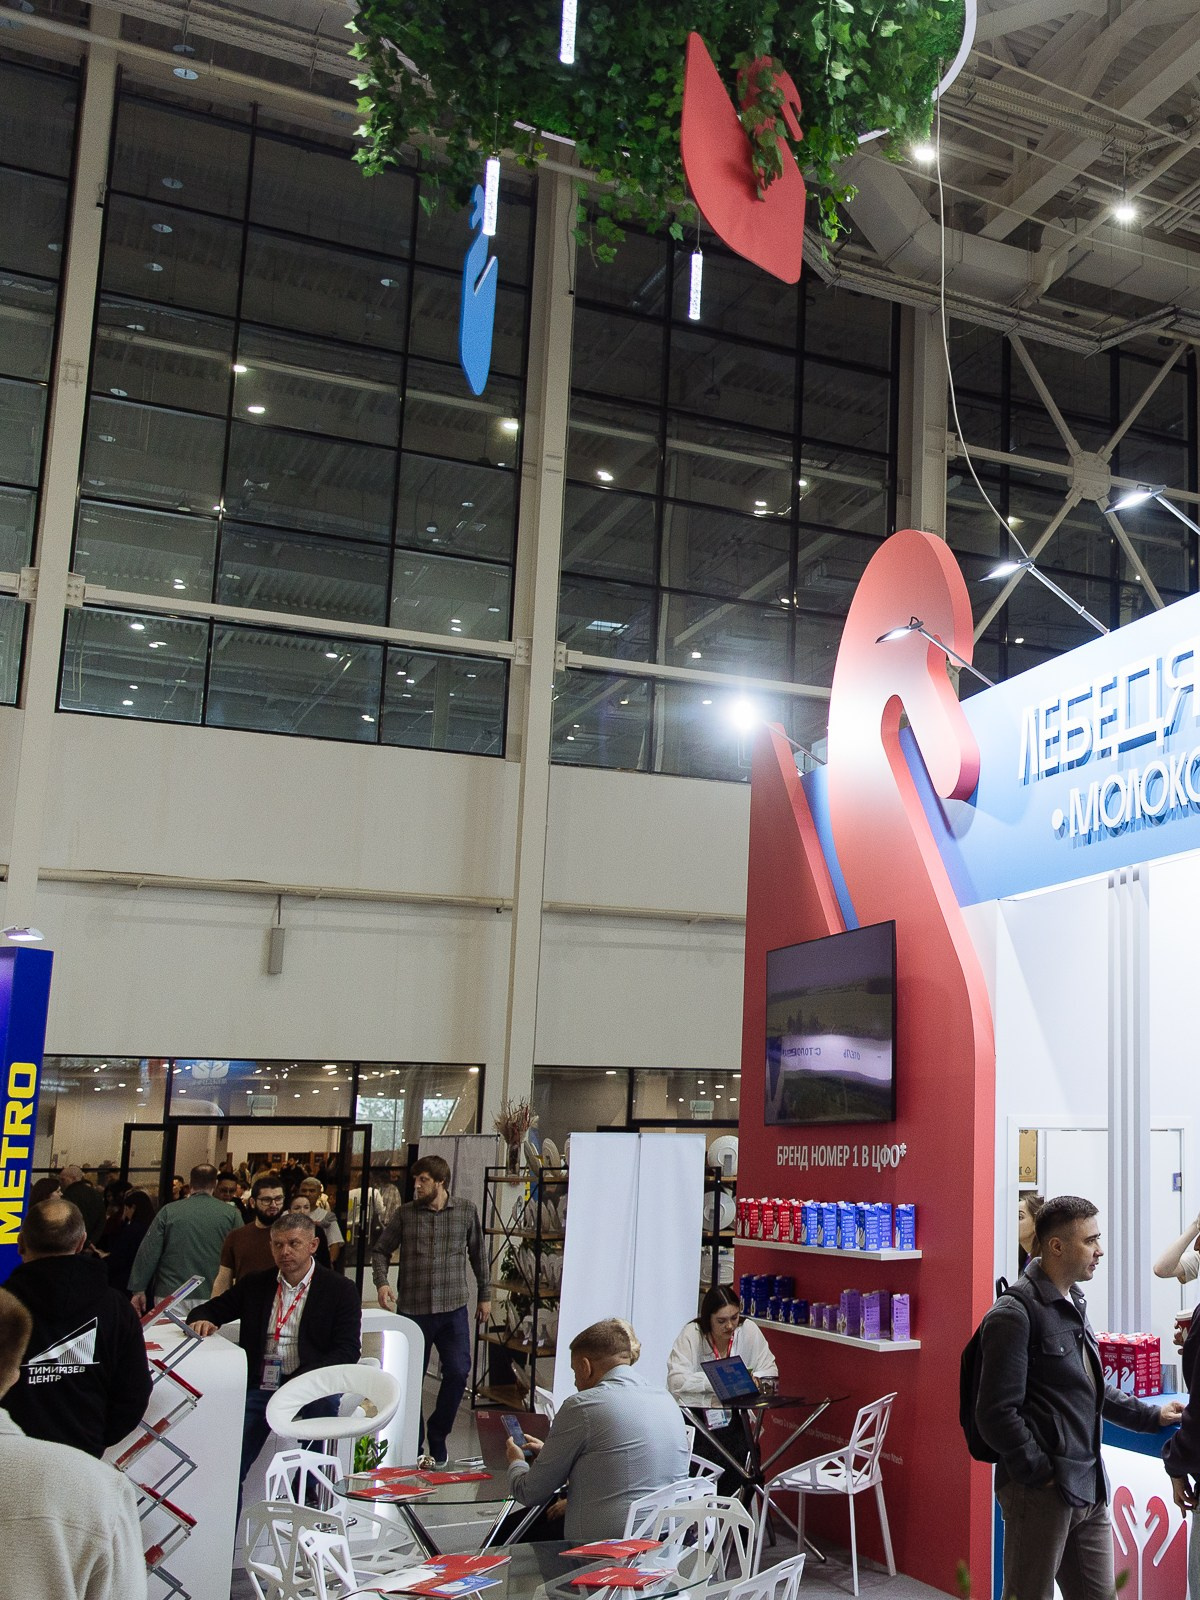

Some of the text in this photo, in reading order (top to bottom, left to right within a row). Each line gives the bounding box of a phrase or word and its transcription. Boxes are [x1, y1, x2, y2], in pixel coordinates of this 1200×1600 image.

[0, 1062, 37, 1245] METRO
[777, 1146, 808, 1171] БРЕНД
[811, 1146, 850, 1167] НОМЕР
[853, 1146, 858, 1167] 1
[862, 1146, 869, 1167] В
[28, 1374, 62, 1385] ЦЕНТР
